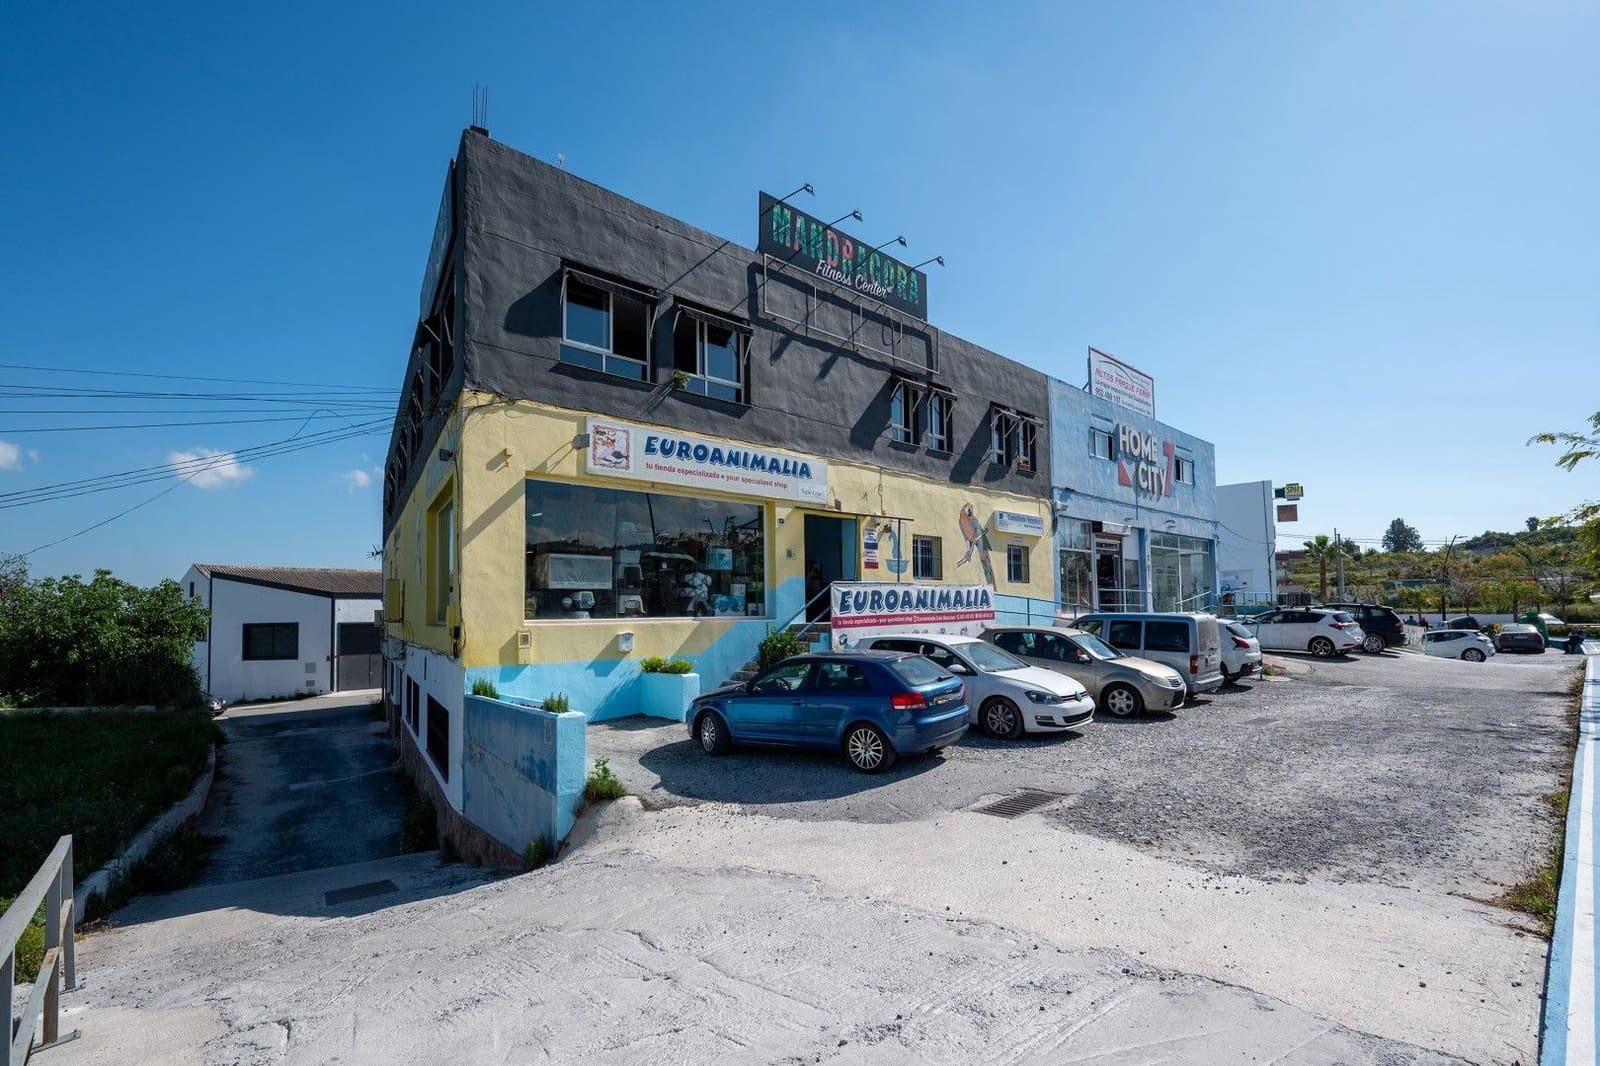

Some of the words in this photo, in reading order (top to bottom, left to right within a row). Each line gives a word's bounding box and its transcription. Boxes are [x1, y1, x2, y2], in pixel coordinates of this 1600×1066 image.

[772, 204, 919, 303] MANDRAGORA
[815, 259, 853, 286] Fitness
[855, 274, 889, 298] Center
[644, 436, 813, 480] EUROANIMALIA
[1118, 423, 1158, 462] HOME
[655, 463, 676, 473] tienda
[677, 467, 720, 479] especializada
[726, 474, 740, 482] your
[741, 476, 773, 487] specialized
[774, 480, 788, 490] shop
[1138, 463, 1167, 496] CITY
[839, 589, 992, 614] EUROANIMALIA
